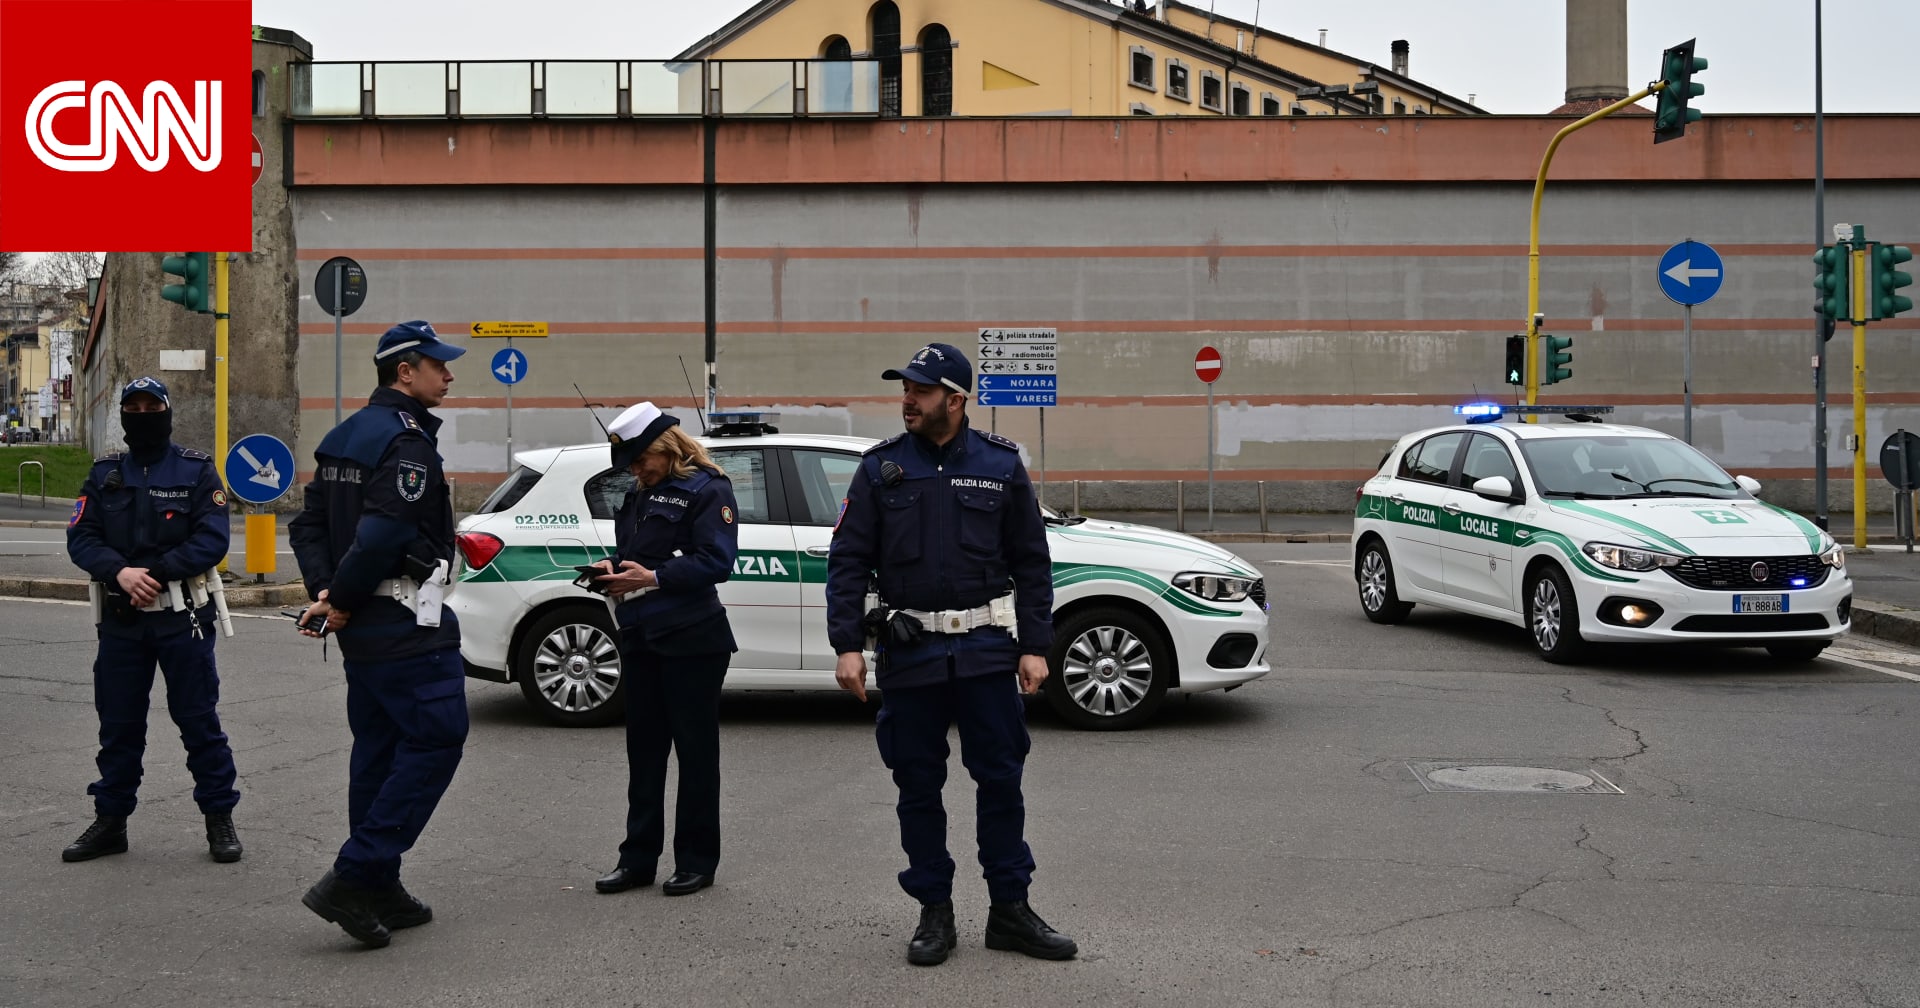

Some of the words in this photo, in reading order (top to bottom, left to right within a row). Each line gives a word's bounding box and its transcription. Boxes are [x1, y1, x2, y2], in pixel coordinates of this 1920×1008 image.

[951, 479, 977, 487] POLIZIA
[979, 480, 1004, 492] LOCALE
[669, 497, 689, 507] LOCALE
[515, 514, 579, 524] 02.0208
[1403, 506, 1436, 525] POLIZIA
[1460, 516, 1499, 538] LOCALE
